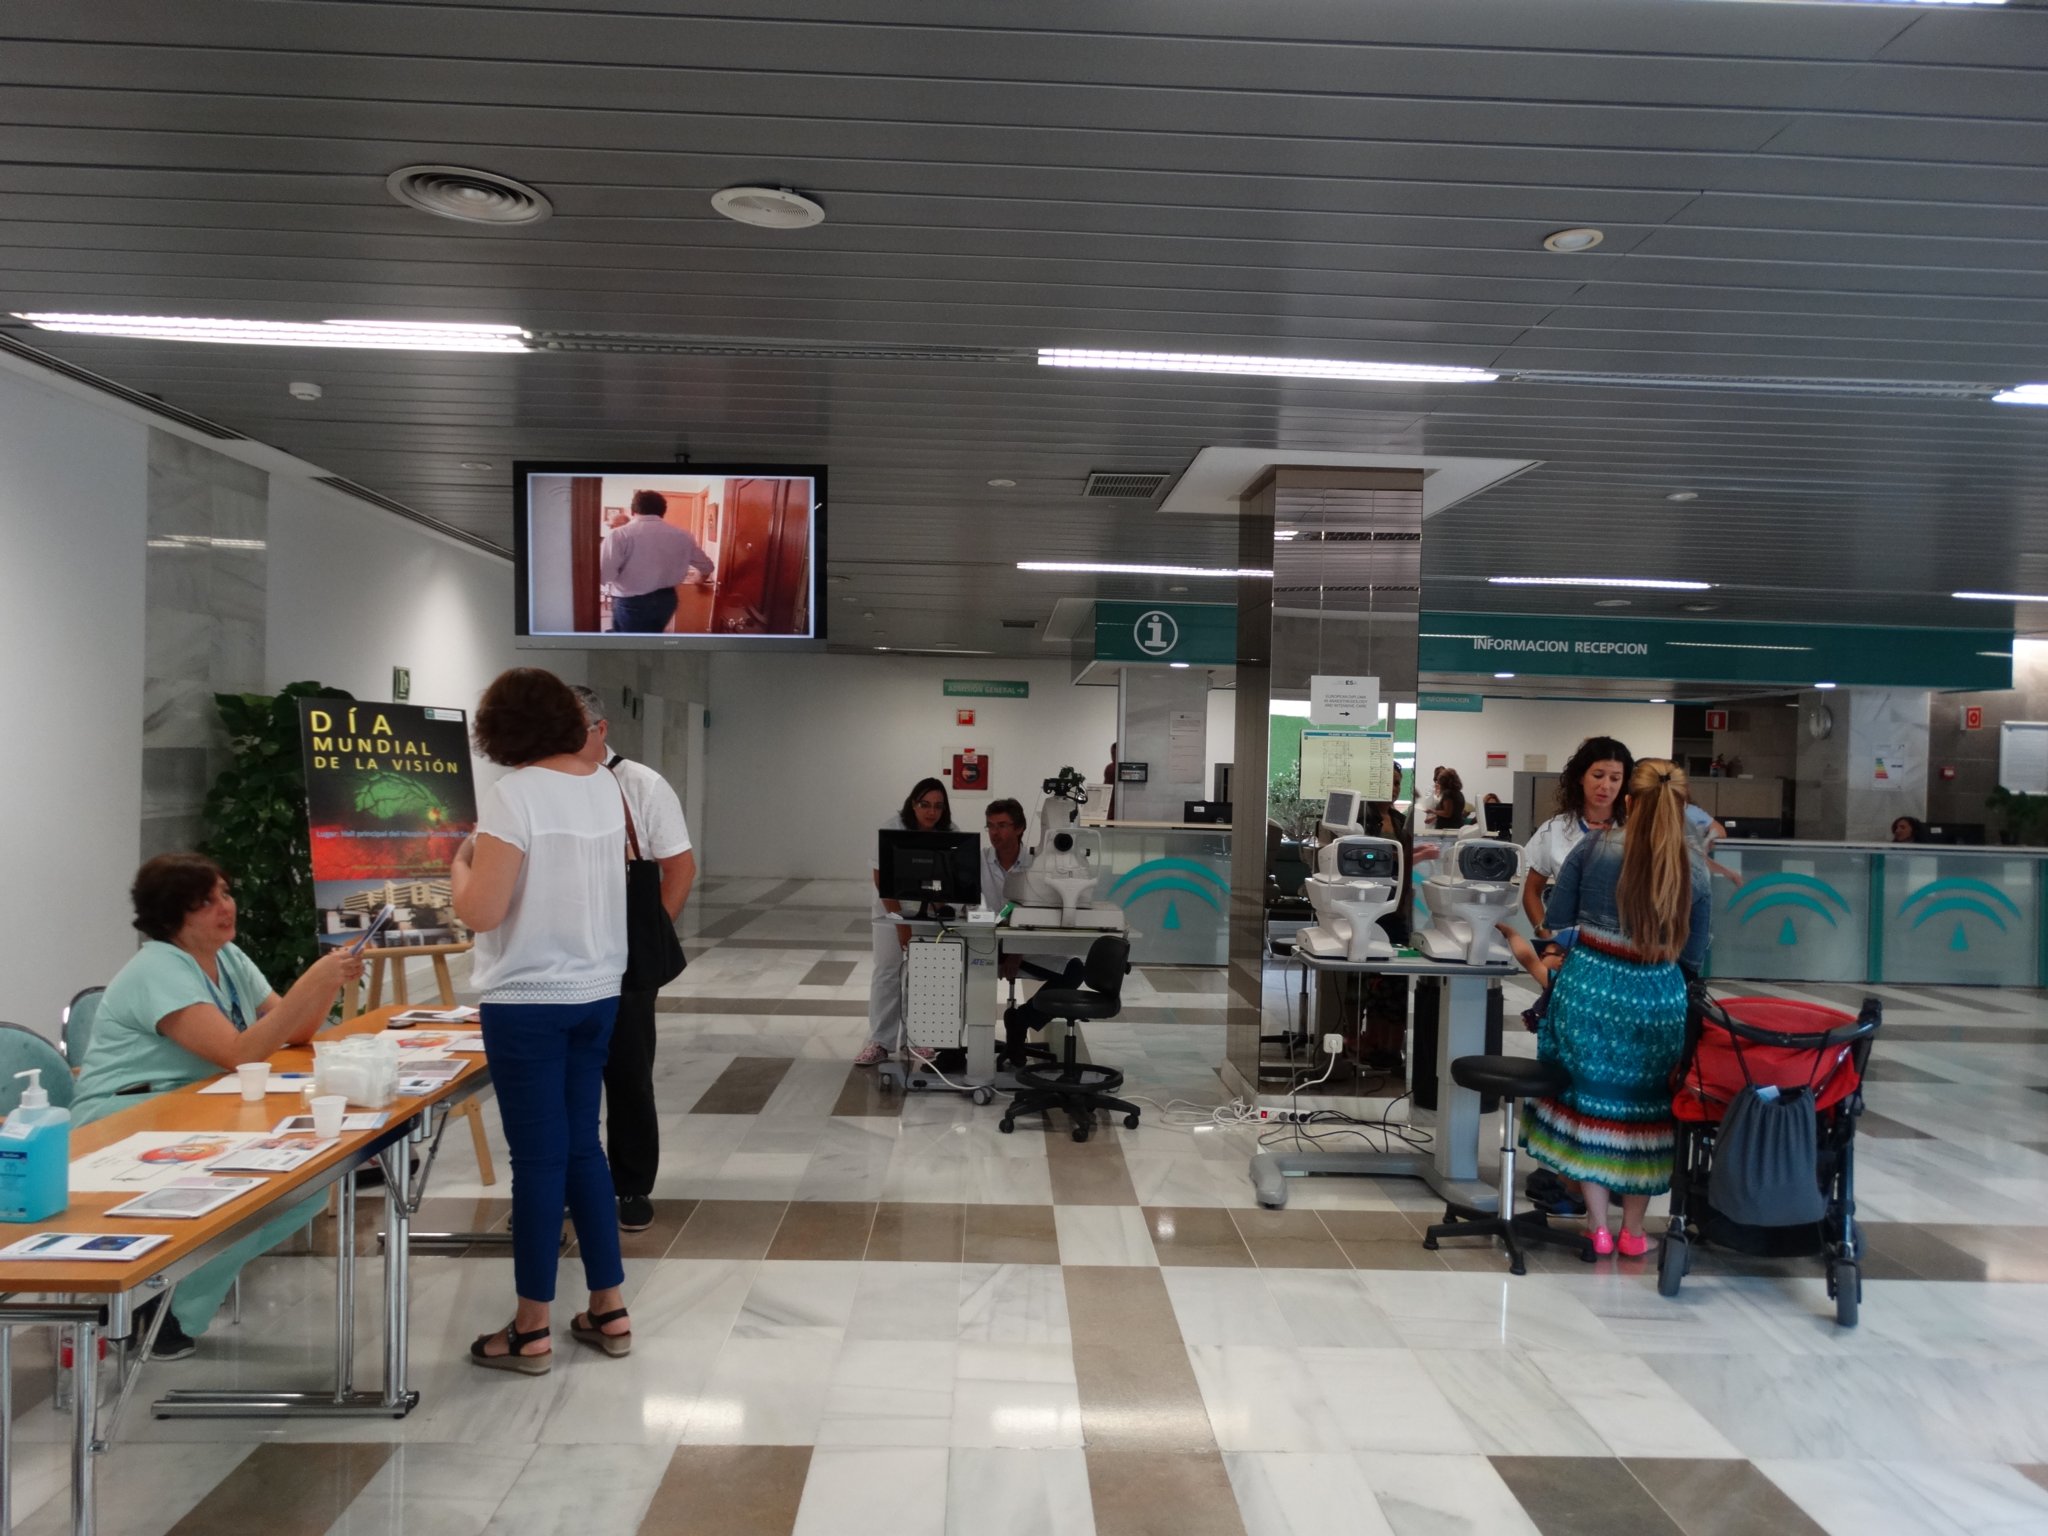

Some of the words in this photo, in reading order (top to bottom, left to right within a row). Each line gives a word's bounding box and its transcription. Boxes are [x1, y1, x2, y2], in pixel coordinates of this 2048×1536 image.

[1473, 638, 1569, 653] INFORMACION
[1574, 641, 1648, 655] RECEPCION
[310, 707, 393, 736] DÍA
[313, 737, 432, 756] MUNDIAL
[314, 757, 341, 769] DE
[355, 757, 379, 770] LA
[391, 758, 459, 773] VISIÓN
